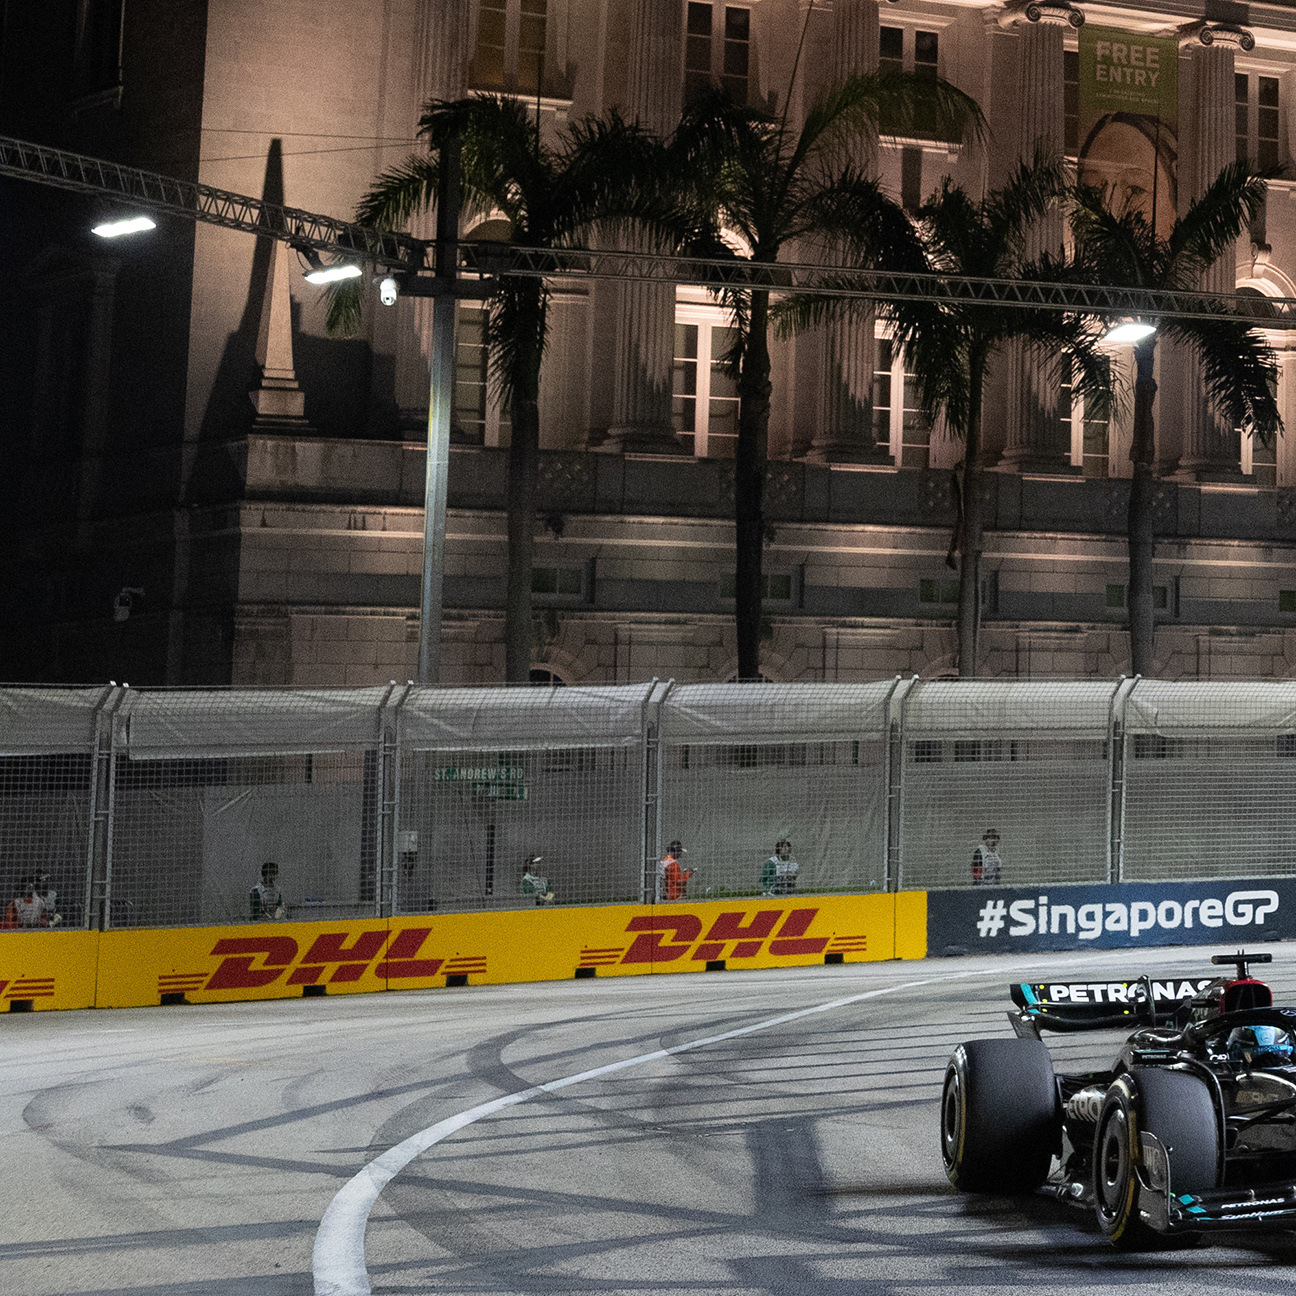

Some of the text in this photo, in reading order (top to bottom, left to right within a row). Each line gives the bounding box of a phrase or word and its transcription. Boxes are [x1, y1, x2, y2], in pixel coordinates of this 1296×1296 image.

[1096, 40, 1160, 68] FREE
[1096, 64, 1160, 88] ENTRY
[509, 768, 524, 780] RD
[976, 889, 1280, 940] #SingaporeGP
[619, 907, 831, 965] DHL
[203, 927, 446, 991] DHL
[1221, 1197, 1286, 1209] PETRONAS
